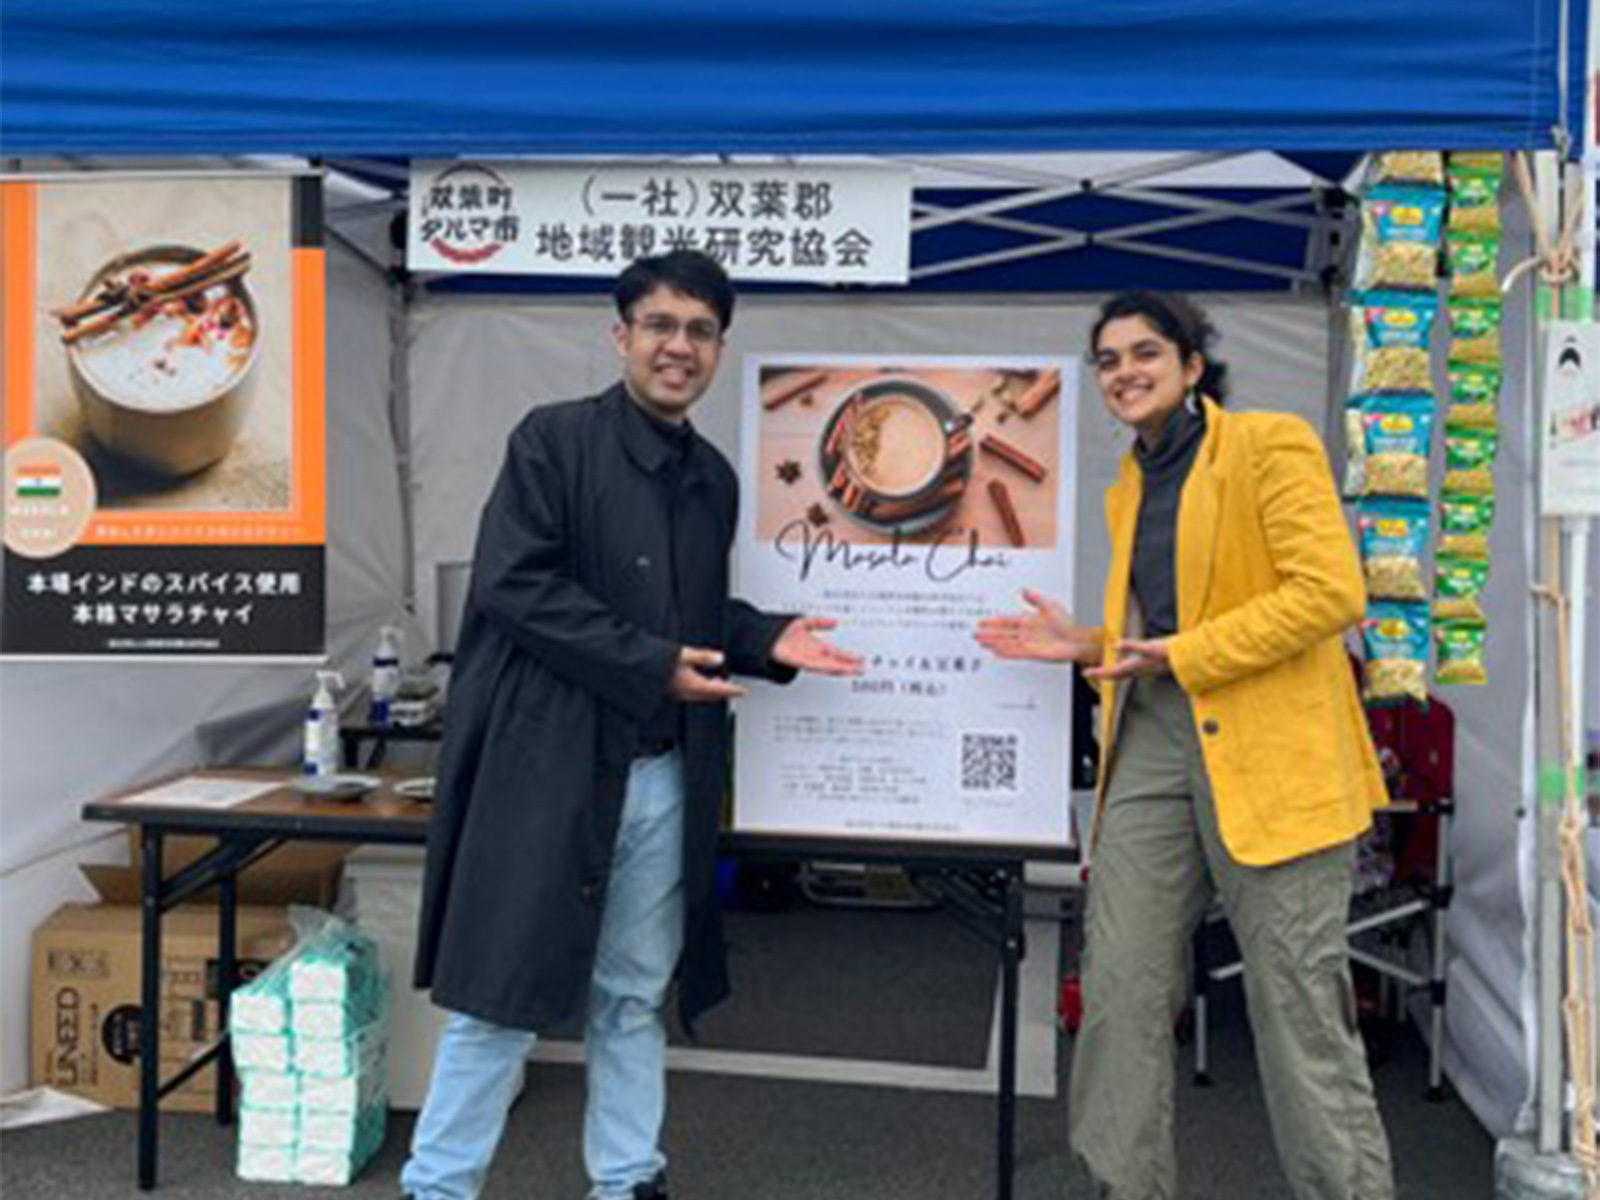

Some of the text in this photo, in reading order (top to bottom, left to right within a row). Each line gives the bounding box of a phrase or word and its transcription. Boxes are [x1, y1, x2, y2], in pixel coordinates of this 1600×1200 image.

[535, 222, 872, 267] 地域観光研究協会
[774, 518, 1011, 583] Masala Chai
[27, 572, 301, 595] 本場インドのスパイス使用
[72, 603, 253, 624] 本格マサラチャイ
